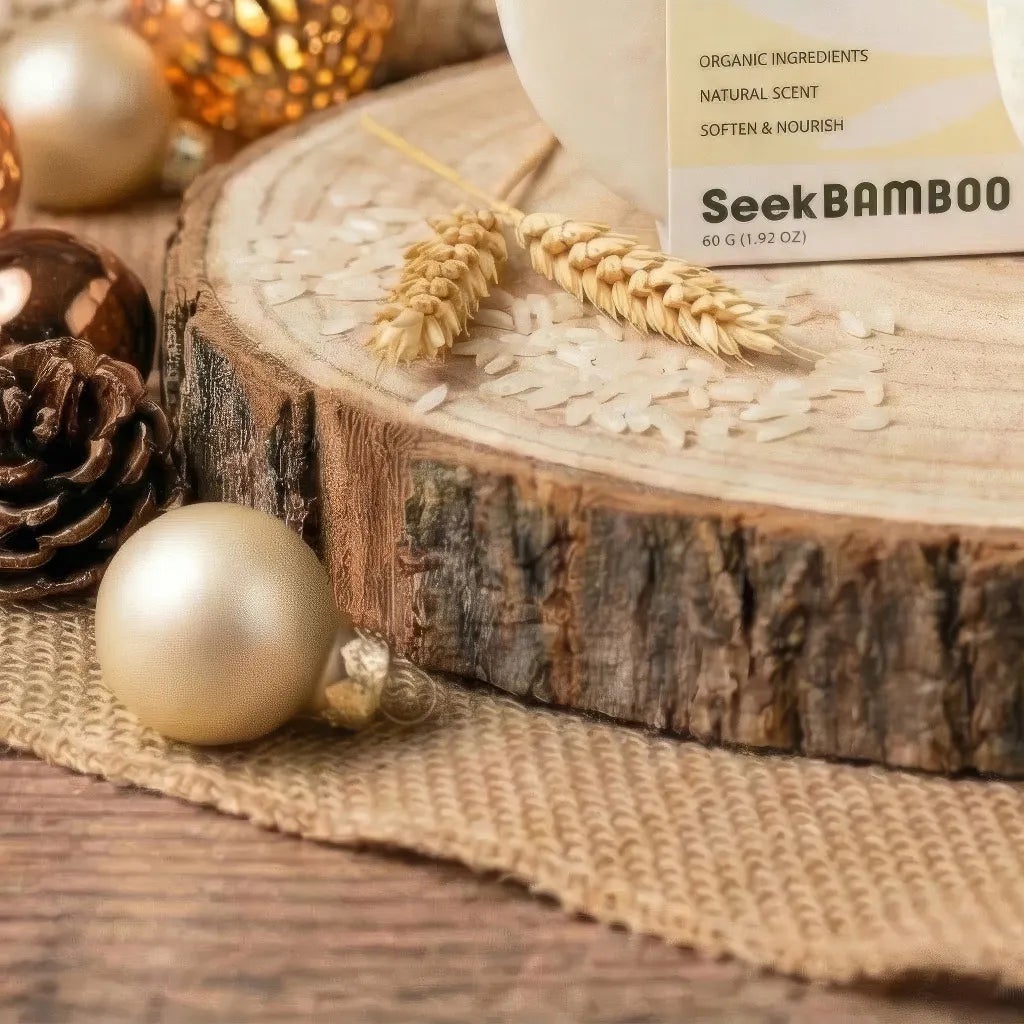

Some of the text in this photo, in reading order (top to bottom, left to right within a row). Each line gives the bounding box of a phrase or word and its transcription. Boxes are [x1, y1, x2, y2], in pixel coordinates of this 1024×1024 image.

[699, 49, 869, 68] ORGANIC INGREDIENTS
[700, 85, 819, 103] NATURAL SCENT
[700, 118, 844, 136] SOFTEN & NOURISH
[702, 175, 1010, 224] SeekBAMBOO
[702, 230, 807, 248] 60 G (1.92 OZ)
